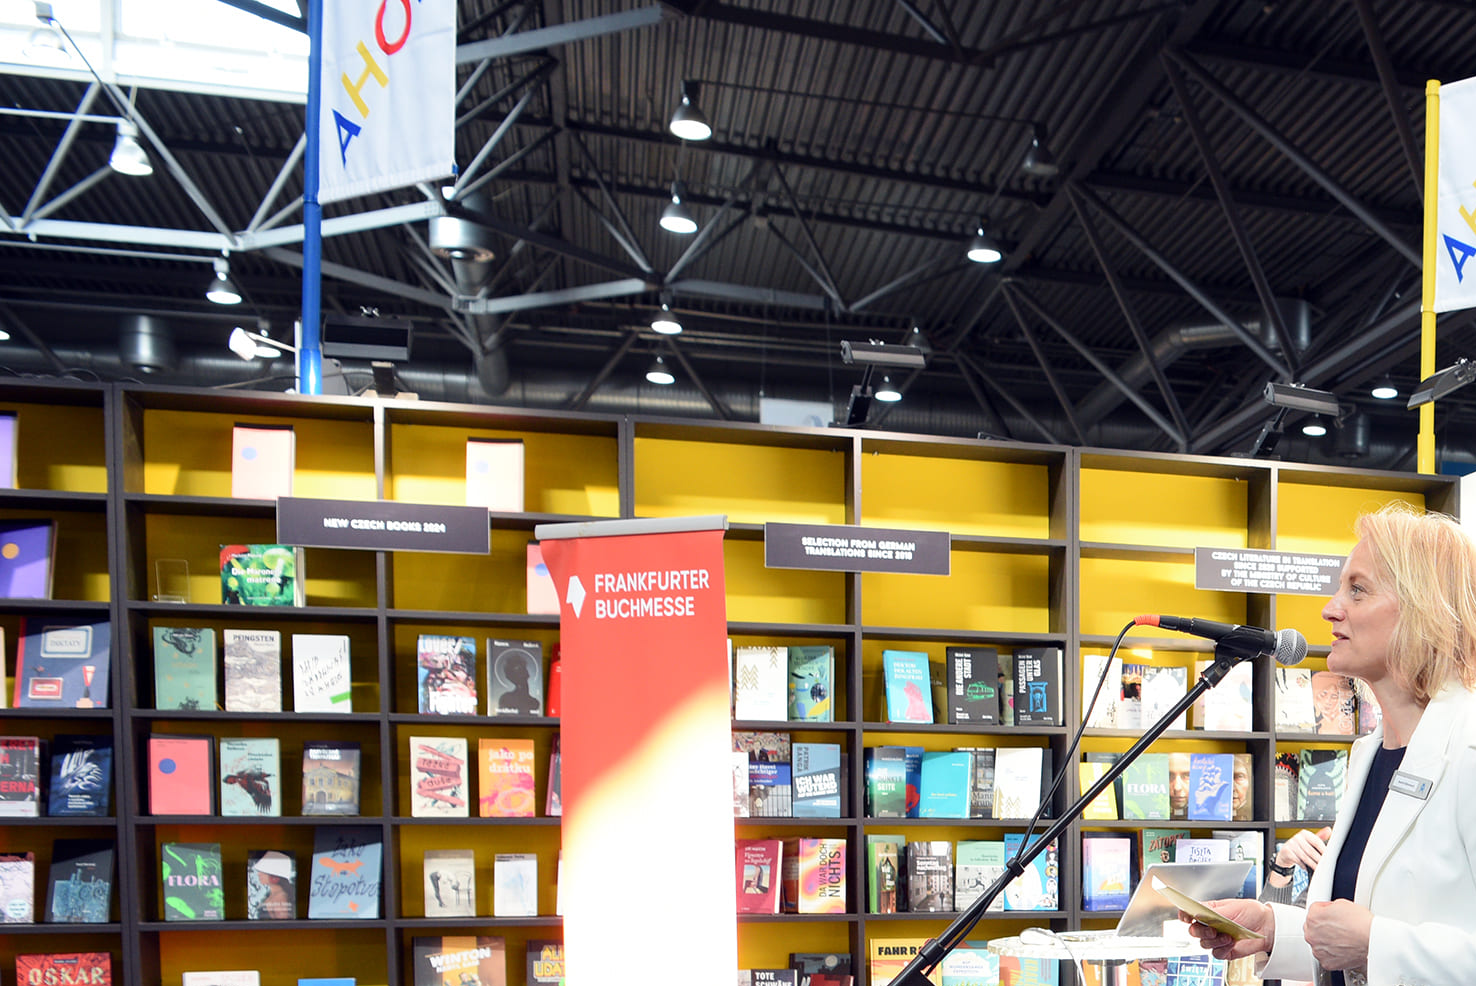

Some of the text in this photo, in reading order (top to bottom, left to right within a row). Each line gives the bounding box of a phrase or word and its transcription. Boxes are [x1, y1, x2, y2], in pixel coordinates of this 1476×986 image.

[323, 517, 349, 528] NEW
[350, 518, 385, 531] CZECH
[386, 520, 422, 532] BOOKS
[801, 536, 916, 551] SELECTION FROM GERMAN
[805, 546, 866, 558] TRANSLATIONS
[868, 549, 893, 559] SINCE
[1212, 552, 1340, 567] CZECH LITERATURE IN TRANSLATION
[1234, 562, 1257, 570] SINCE
[1276, 564, 1319, 574] SUPPORTED
[594, 569, 710, 593] FRANKFURTER
[1221, 569, 1331, 583] BY THE MINISTRY OF CULTURE
[1231, 578, 1322, 591] OF THE CZECH REPUBLIC
[595, 596, 696, 619] BUCHMESSE
[963, 658, 972, 679] STADT
[1033, 659, 1041, 677] GLAS
[1018, 659, 1026, 694] PASSAGEN
[488, 747, 533, 761] jako po
[795, 773, 836, 786] ICH WAR
[877, 783, 896, 792] SEITE
[1127, 783, 1167, 794] FLORA
[168, 874, 219, 887] FLORA
[829, 850, 841, 898] NICHTS
[819, 886, 827, 898] DA
[430, 947, 492, 969] WINTON
[878, 946, 907, 956] FAHR
[28, 967, 105, 986] OSKAR
[755, 972, 775, 981] TOTE
